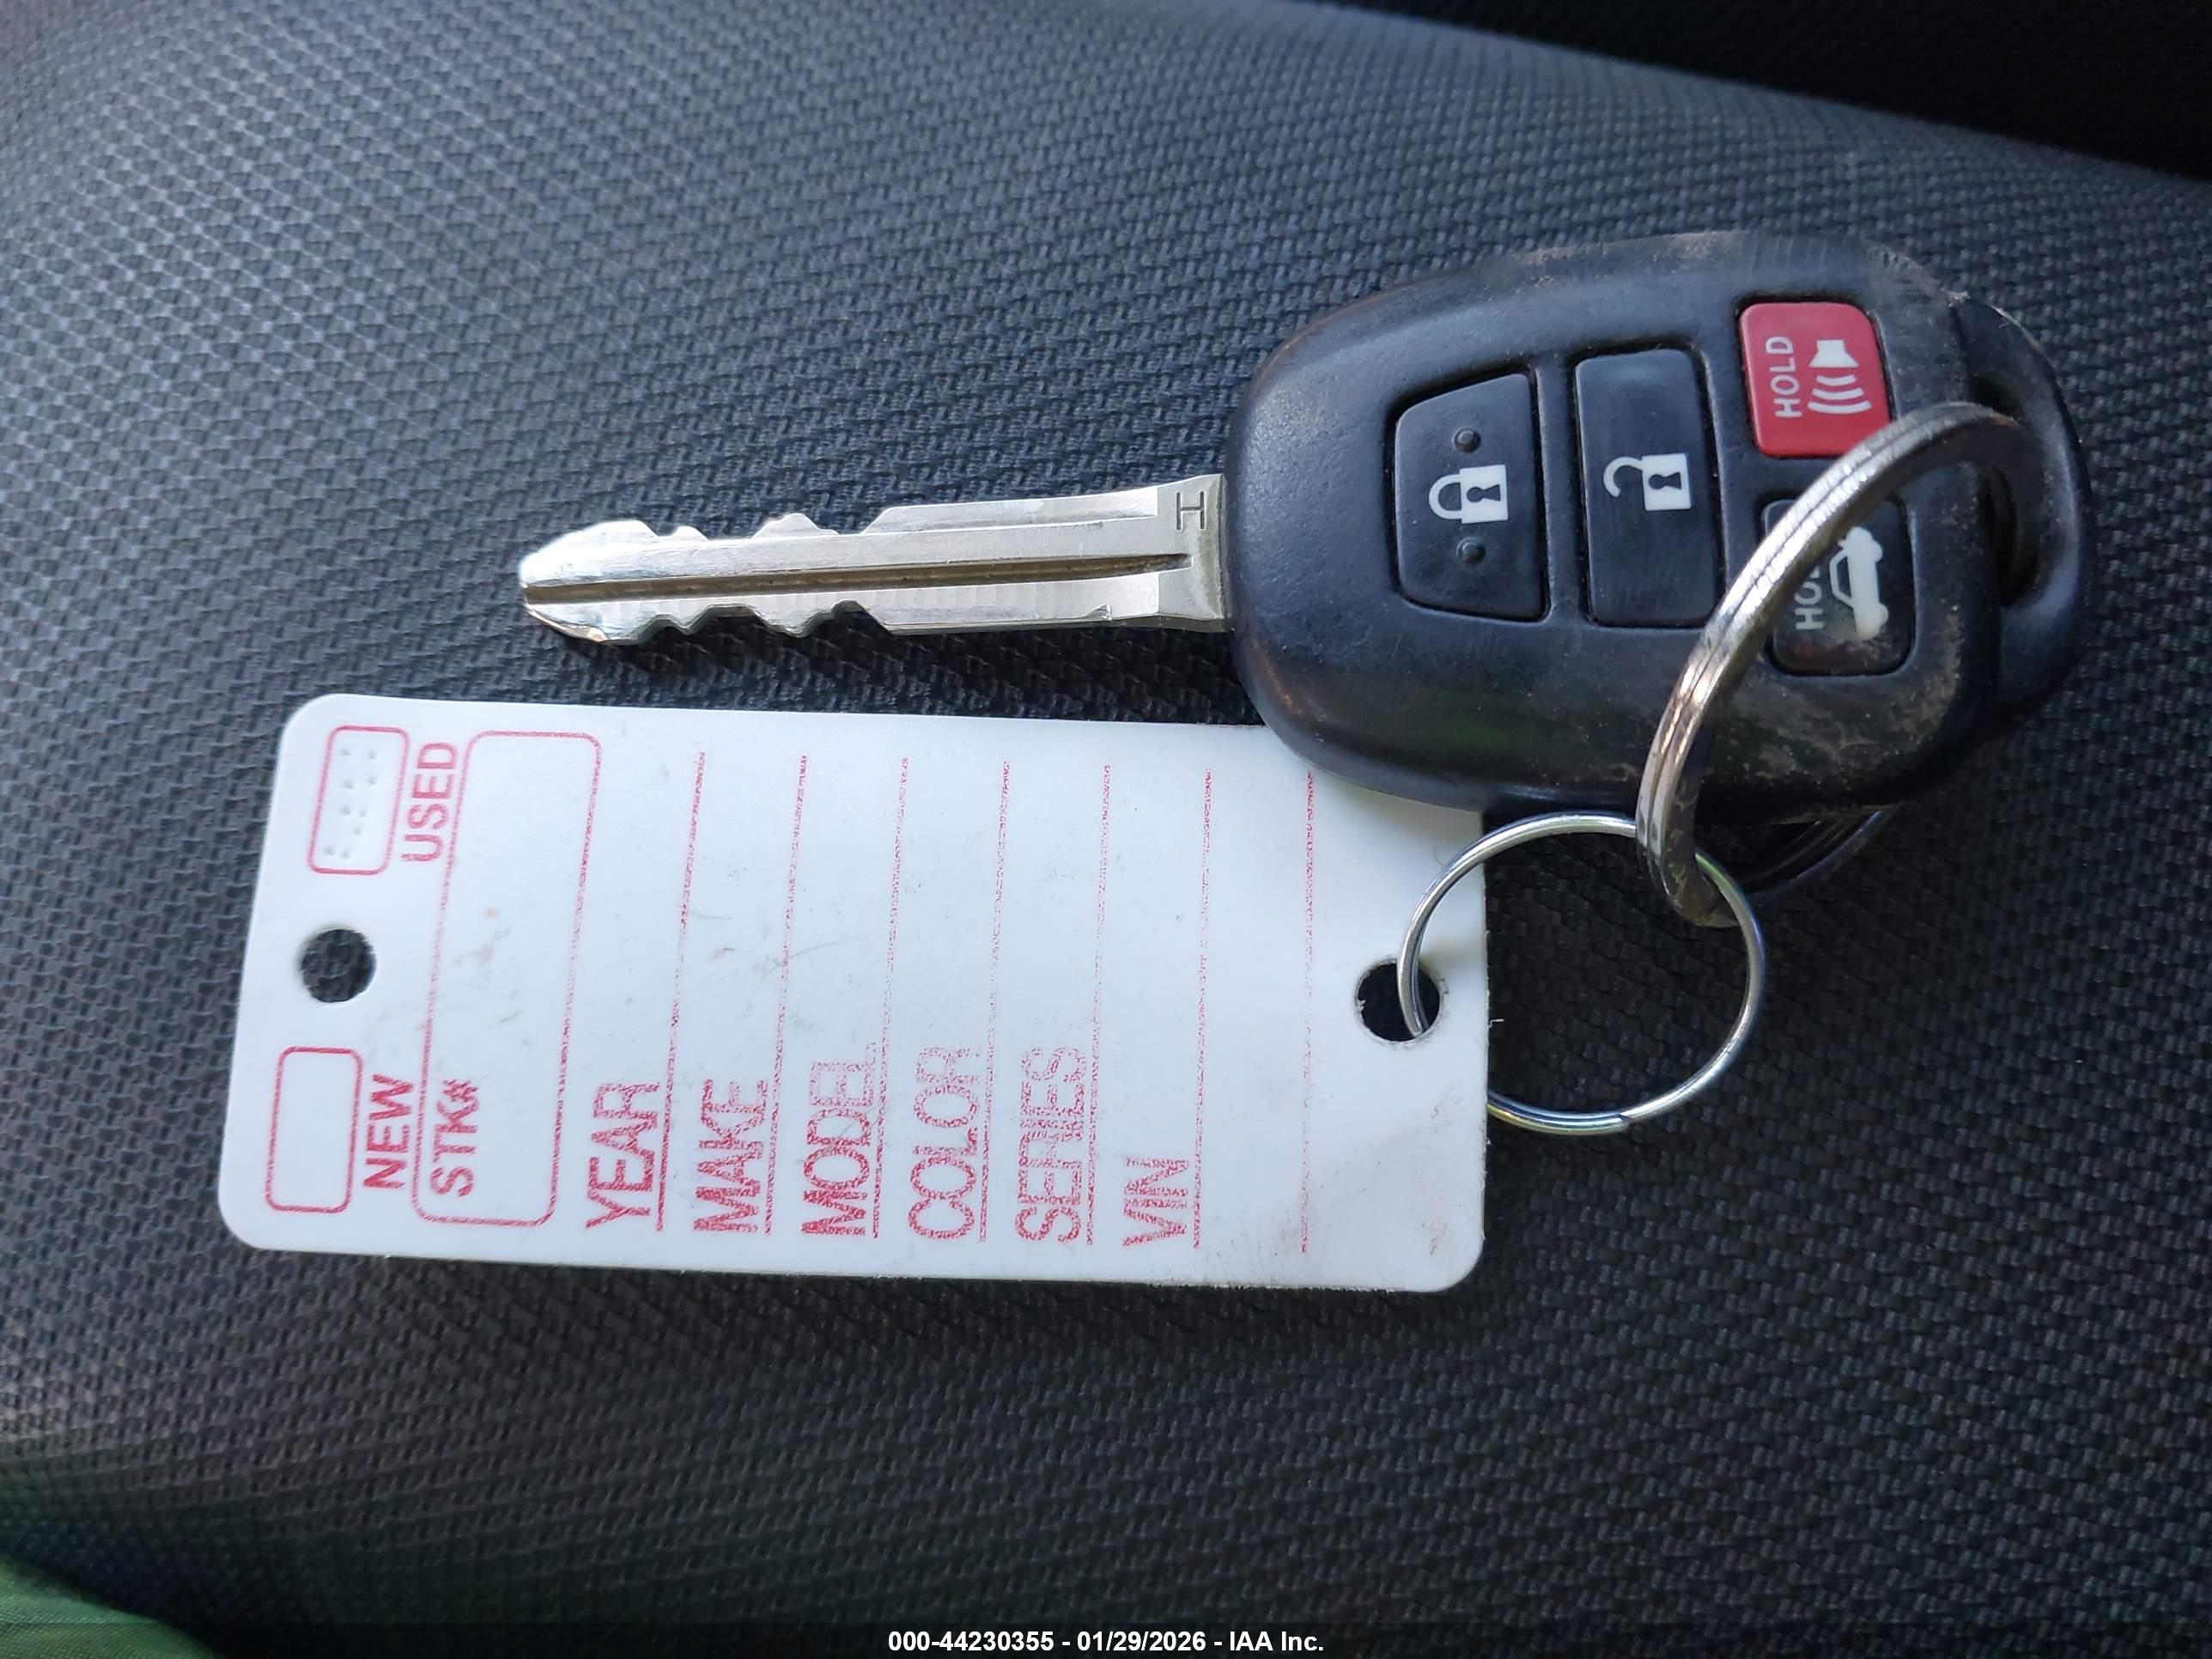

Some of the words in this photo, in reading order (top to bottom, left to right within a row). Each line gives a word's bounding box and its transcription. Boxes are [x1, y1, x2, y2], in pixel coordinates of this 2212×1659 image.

[1765, 336, 1802, 418] HOLD
[1176, 491, 1206, 531] H
[1794, 564, 1824, 630] HO
[401, 743, 458, 862] USED
[364, 1074, 415, 1188] NEW
[430, 1079, 480, 1196] STK#
[586, 1082, 659, 1228] YEAR
[693, 1079, 768, 1234] MAKE
[800, 1043, 878, 1237] MODEL
[907, 1046, 981, 1242] COLOR
[1016, 1047, 1088, 1244] SERIES
[1122, 1157, 1190, 1248] VIN
